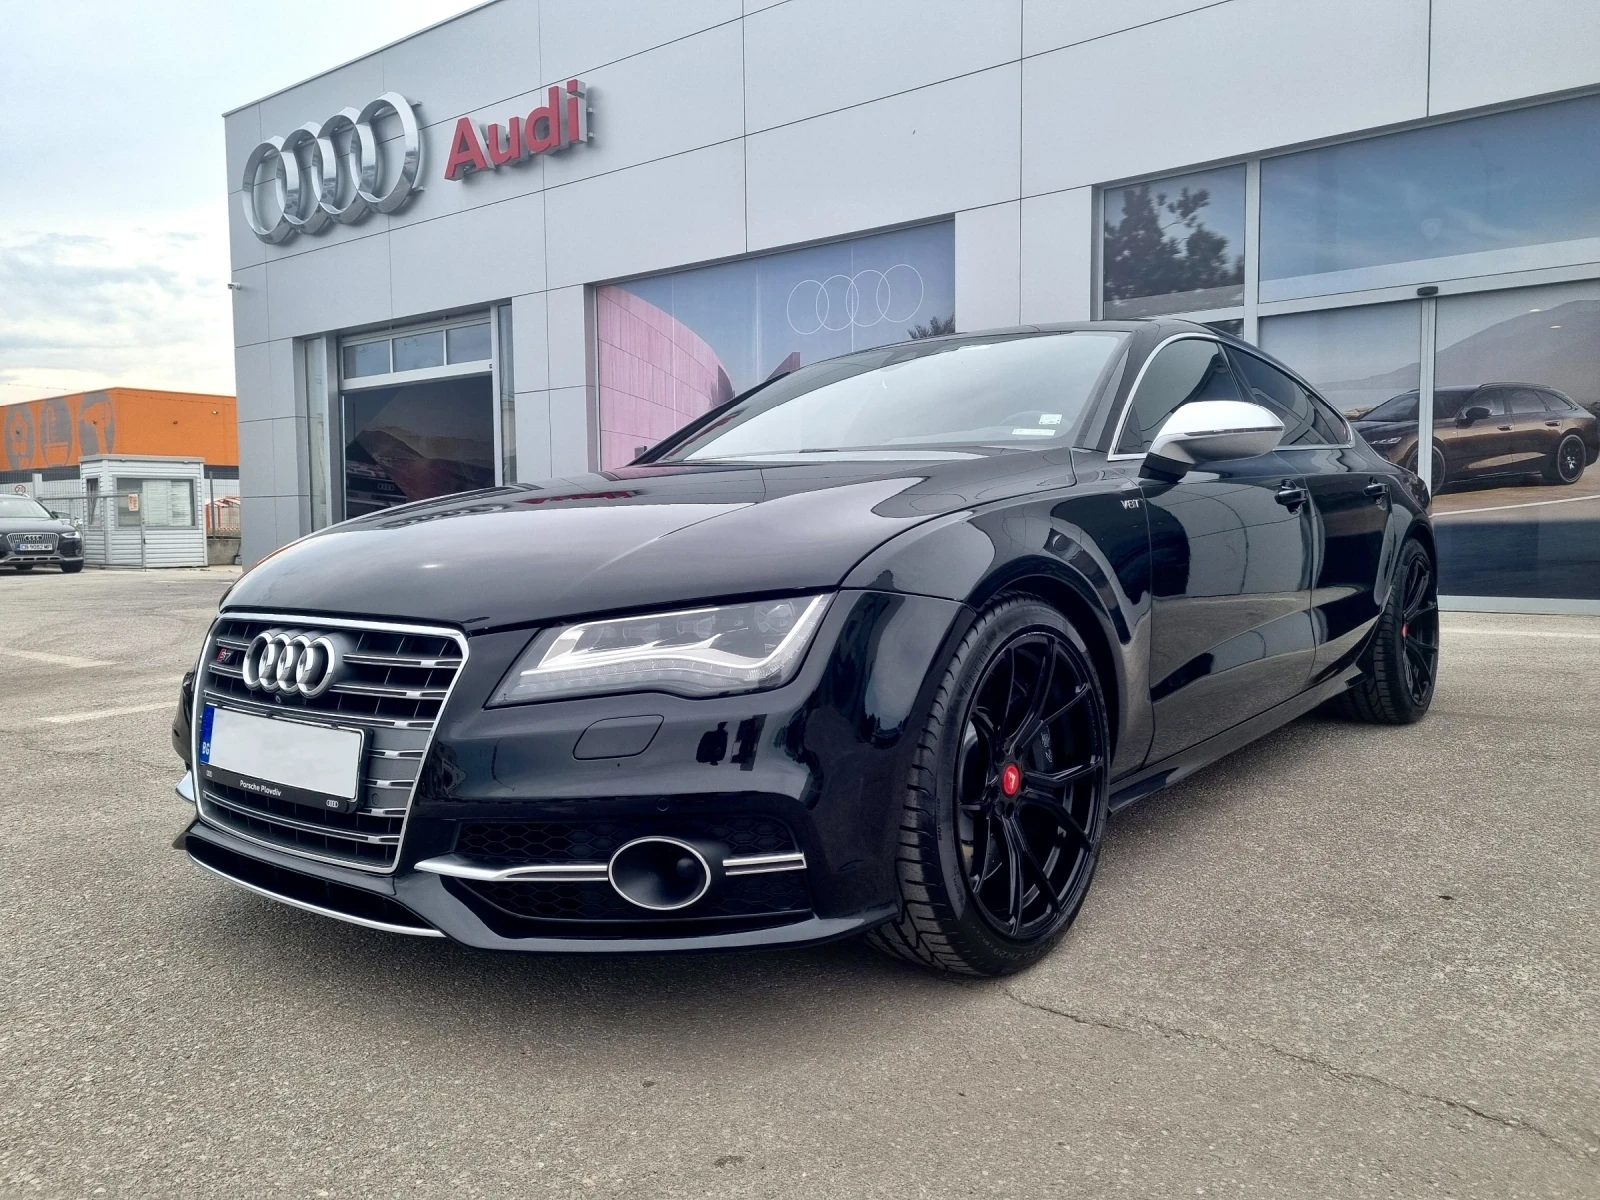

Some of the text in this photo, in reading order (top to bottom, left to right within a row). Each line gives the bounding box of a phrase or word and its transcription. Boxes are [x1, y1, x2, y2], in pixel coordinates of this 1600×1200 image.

[444, 79, 583, 180] Audi
[217, 648, 232, 662] S7
[202, 741, 210, 755] BG
[240, 779, 282, 797] Porsche Plovdiv
